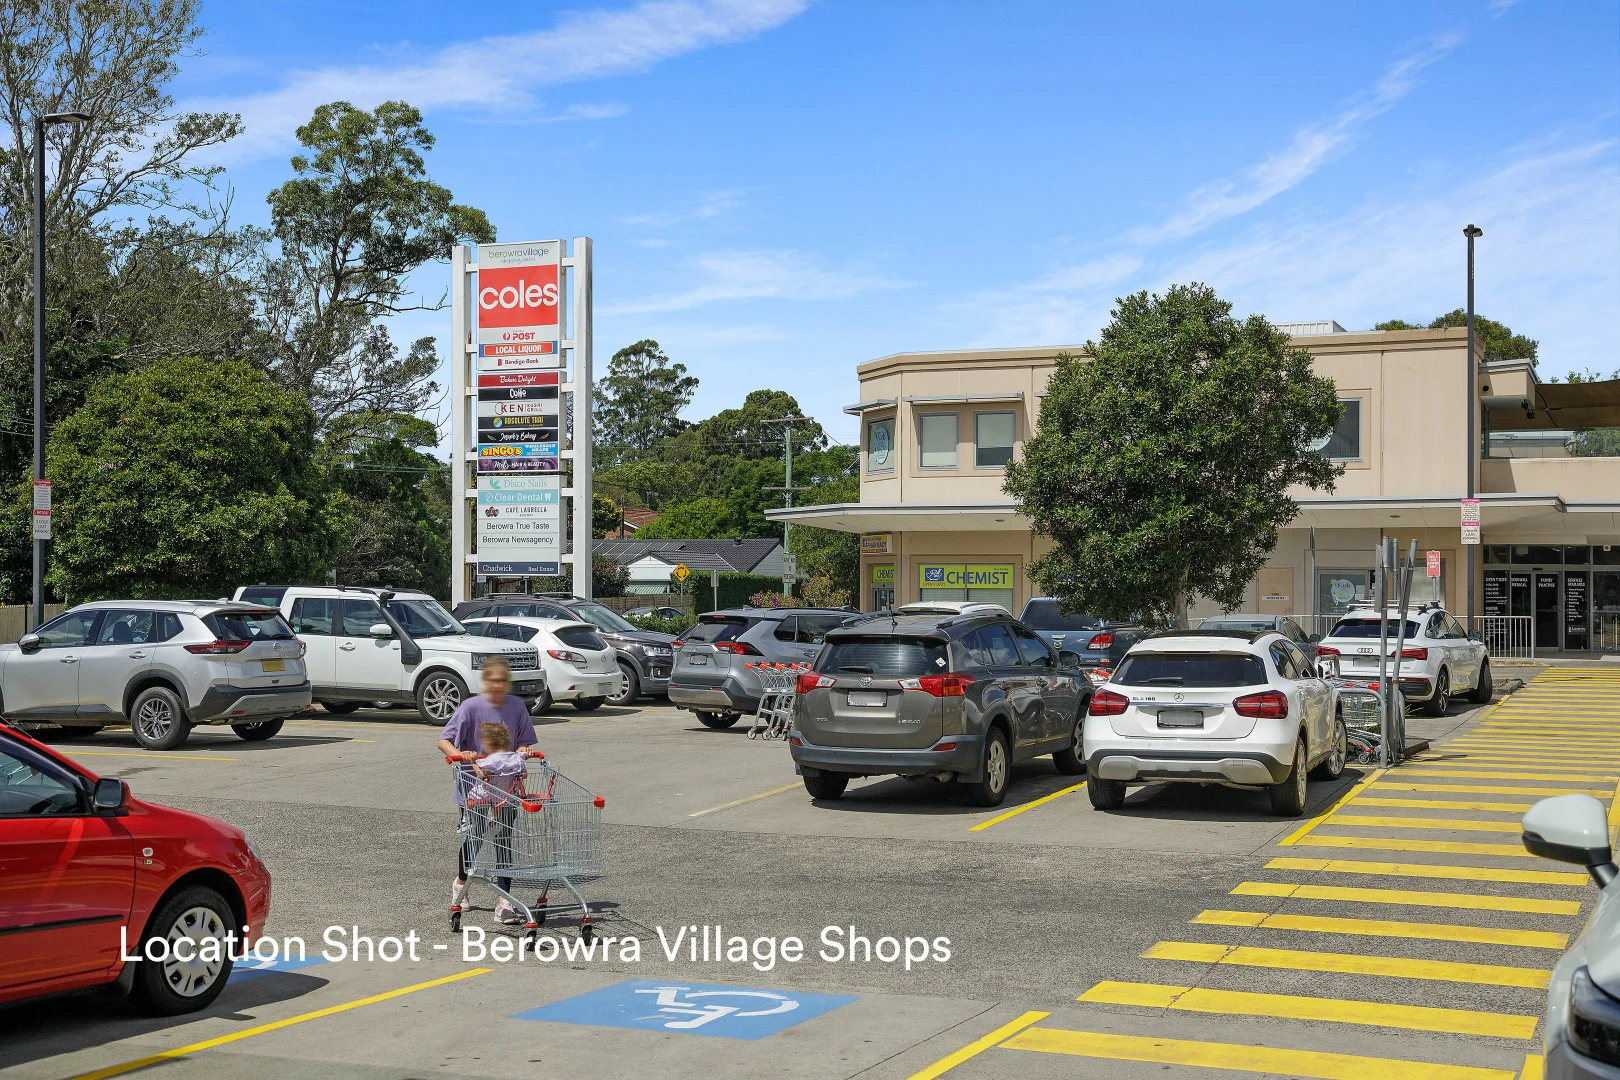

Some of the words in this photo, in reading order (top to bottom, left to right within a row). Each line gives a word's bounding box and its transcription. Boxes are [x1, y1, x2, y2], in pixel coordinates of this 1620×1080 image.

[488, 248, 548, 258] berowravillage
[480, 280, 558, 309] coles
[512, 332, 535, 340] POST
[496, 346, 516, 354] LOCAL
[518, 345, 541, 354] LIQUOR
[518, 375, 536, 385] Delight
[501, 404, 523, 412] KEN
[481, 445, 522, 456] SINGO'S
[504, 480, 525, 488] Disco
[528, 479, 547, 487] Nails
[518, 493, 543, 501] Dental
[512, 536, 553, 544] Newsagency
[946, 572, 1008, 584] CHEMIST
